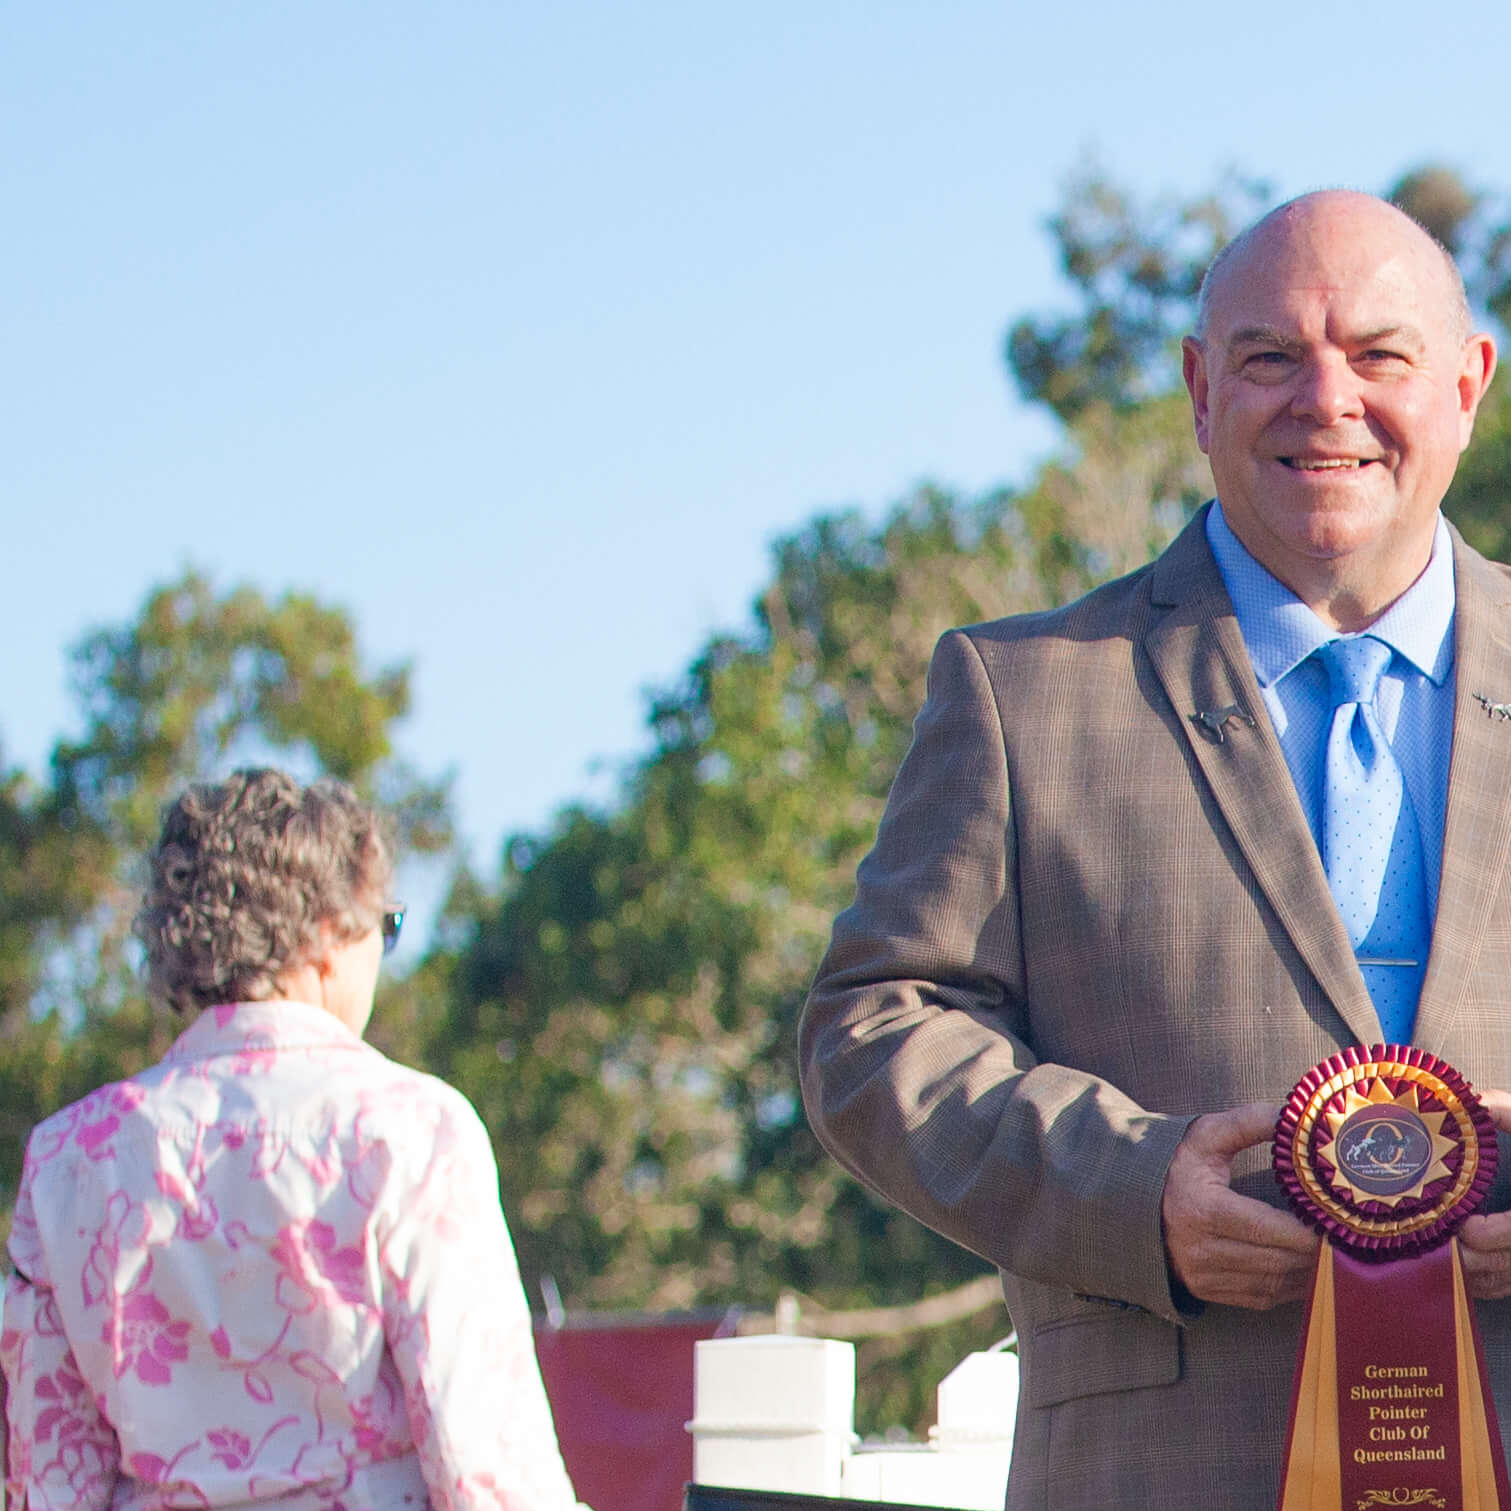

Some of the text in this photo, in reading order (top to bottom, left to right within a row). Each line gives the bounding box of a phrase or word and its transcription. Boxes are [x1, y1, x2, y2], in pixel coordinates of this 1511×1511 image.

[1365, 1364, 1428, 1379] German
[1350, 1384, 1444, 1400] Shorthaired
[1368, 1405, 1428, 1420] Pointer
[1369, 1425, 1430, 1441] Club Of
[1353, 1445, 1446, 1464] Queensland
